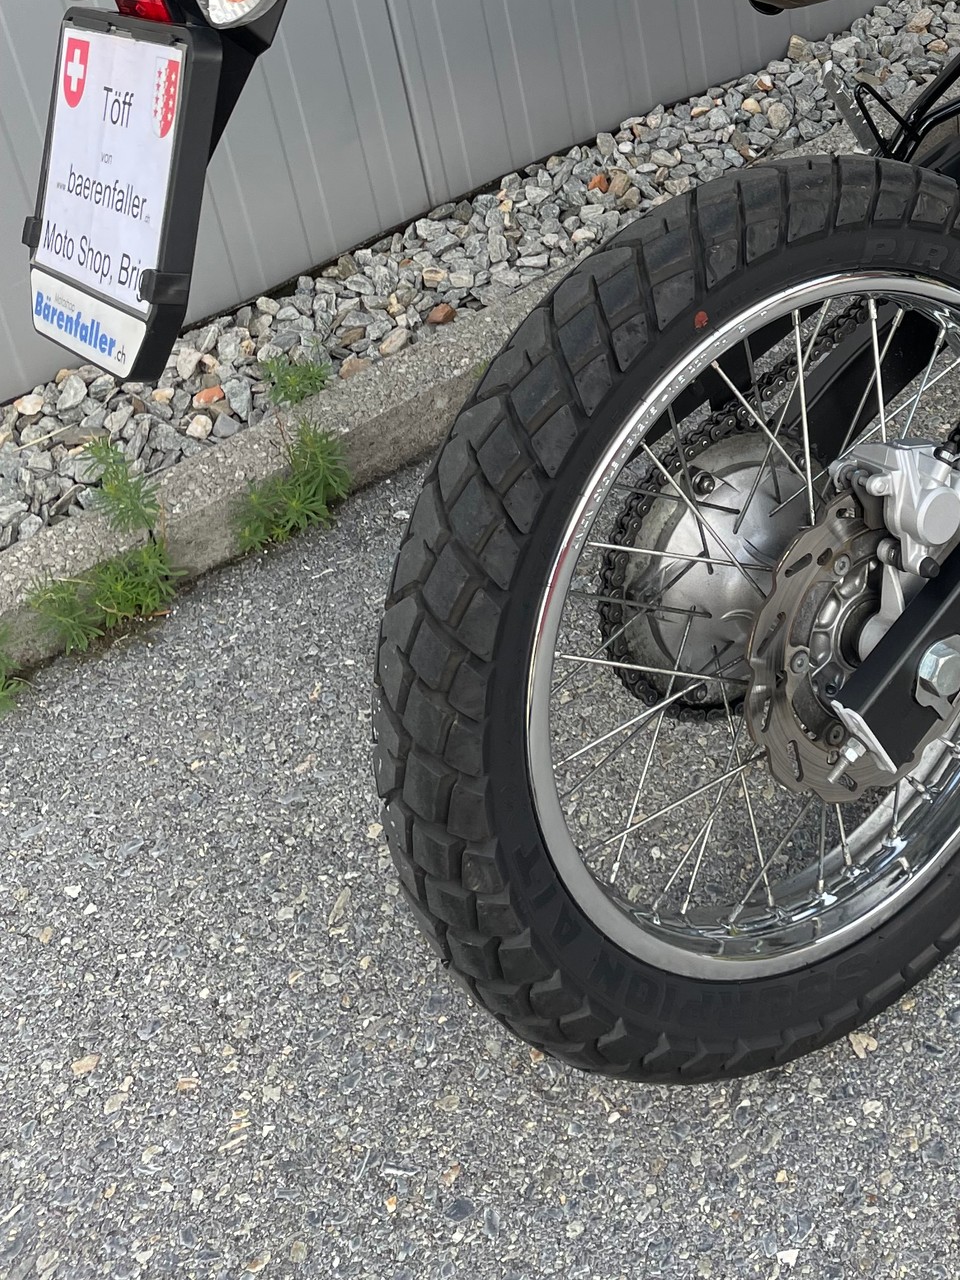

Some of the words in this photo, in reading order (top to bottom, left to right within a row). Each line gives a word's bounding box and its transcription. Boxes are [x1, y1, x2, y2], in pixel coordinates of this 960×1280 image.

[103, 86, 134, 130] Töff
[101, 152, 113, 165] von
[43, 220, 75, 261] Moto
[77, 235, 113, 286] Shop,
